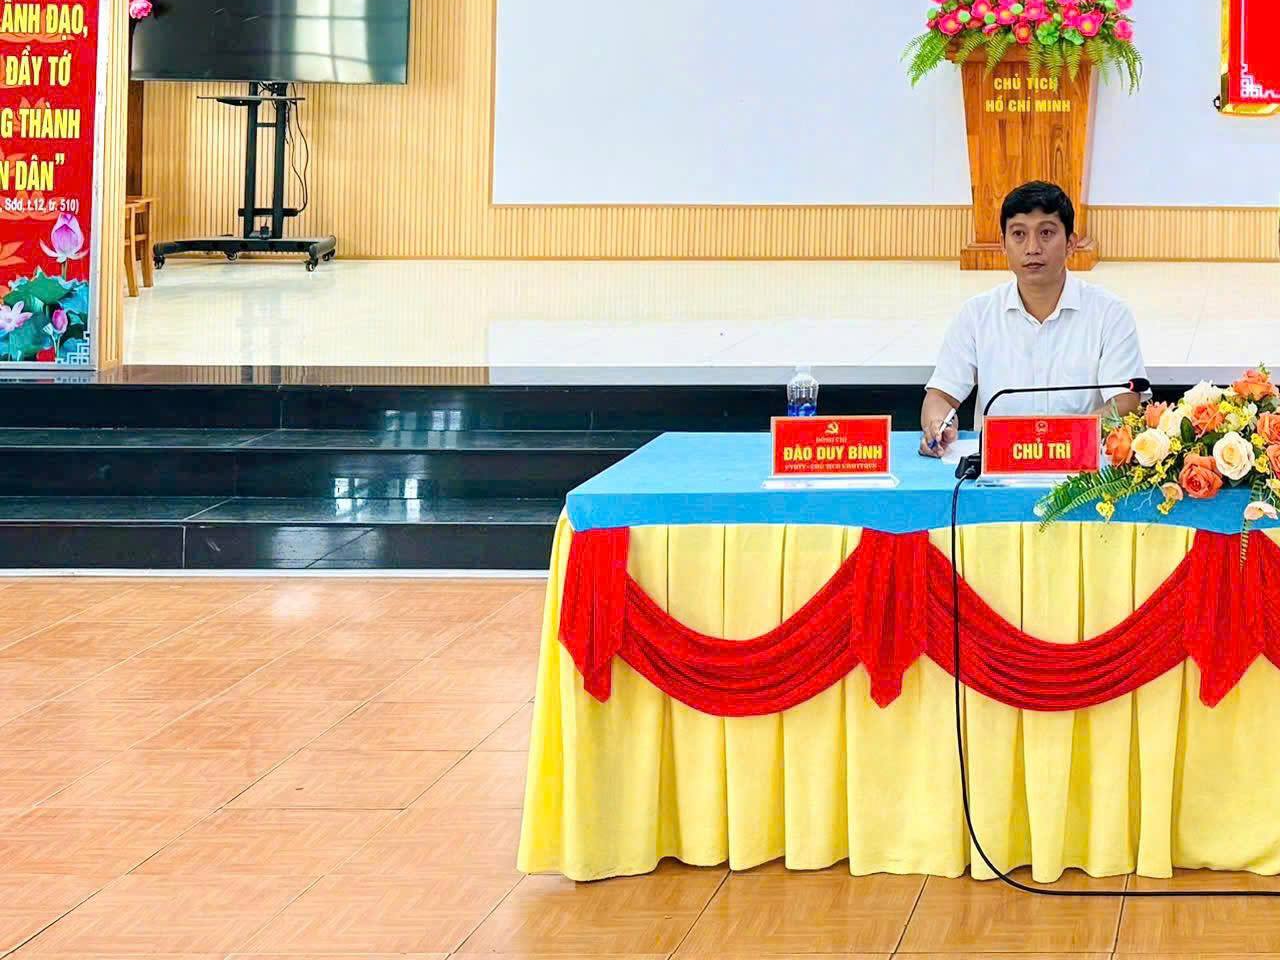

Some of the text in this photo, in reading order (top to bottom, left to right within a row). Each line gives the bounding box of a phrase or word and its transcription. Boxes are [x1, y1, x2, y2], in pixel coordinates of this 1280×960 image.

[46, 3, 88, 40] ĐẠO,
[5, 45, 72, 86] ĐẦY TỚ
[994, 73, 1021, 90] CHỦ
[1008, 96, 1031, 112] CHÍ
[1035, 100, 1071, 112] MINH
[19, 101, 80, 139] THÀNH
[783, 443, 882, 461] ĐÀO DUY BÌNH
[1013, 437, 1071, 459] CHỦ TRÌ
